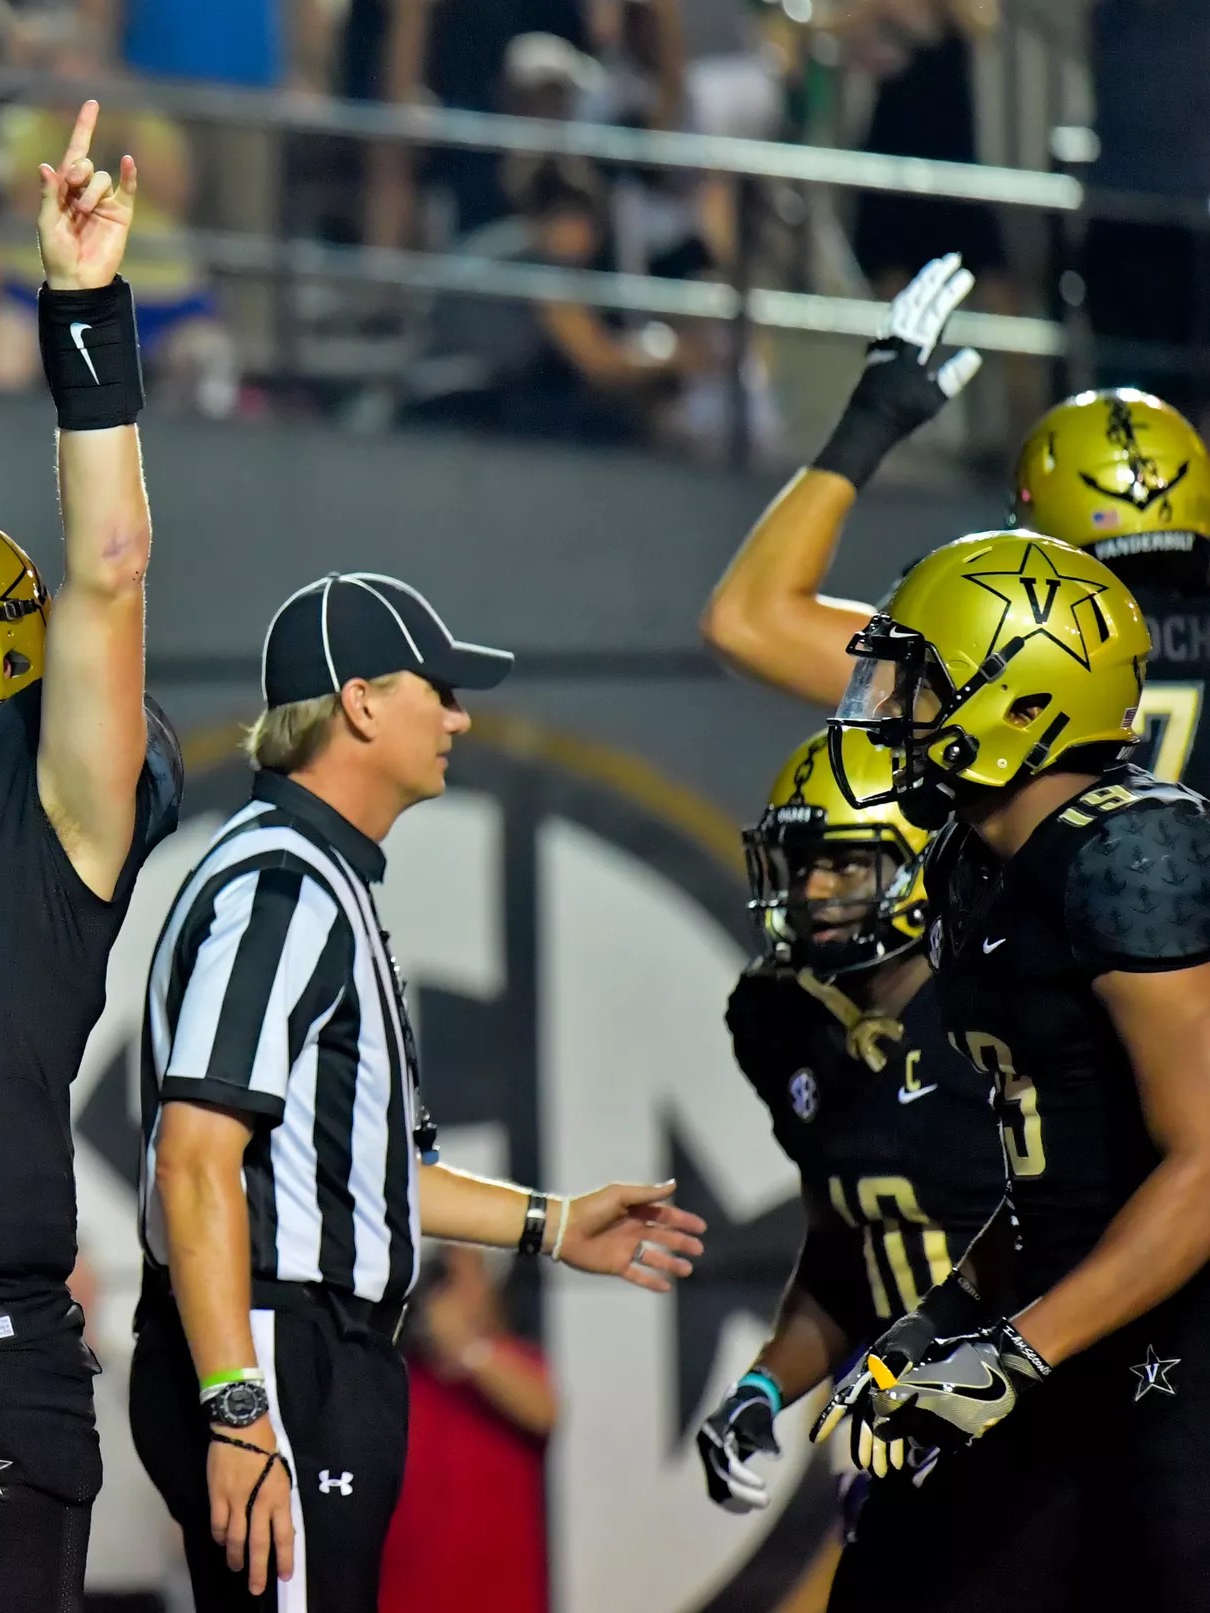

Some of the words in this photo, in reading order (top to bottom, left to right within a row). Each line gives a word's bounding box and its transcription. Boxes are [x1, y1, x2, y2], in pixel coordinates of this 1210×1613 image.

[1019, 577, 1061, 624] V
[906, 1050, 921, 1092] C
[828, 1176, 952, 1318] 10
[1145, 1363, 1160, 1383] V
